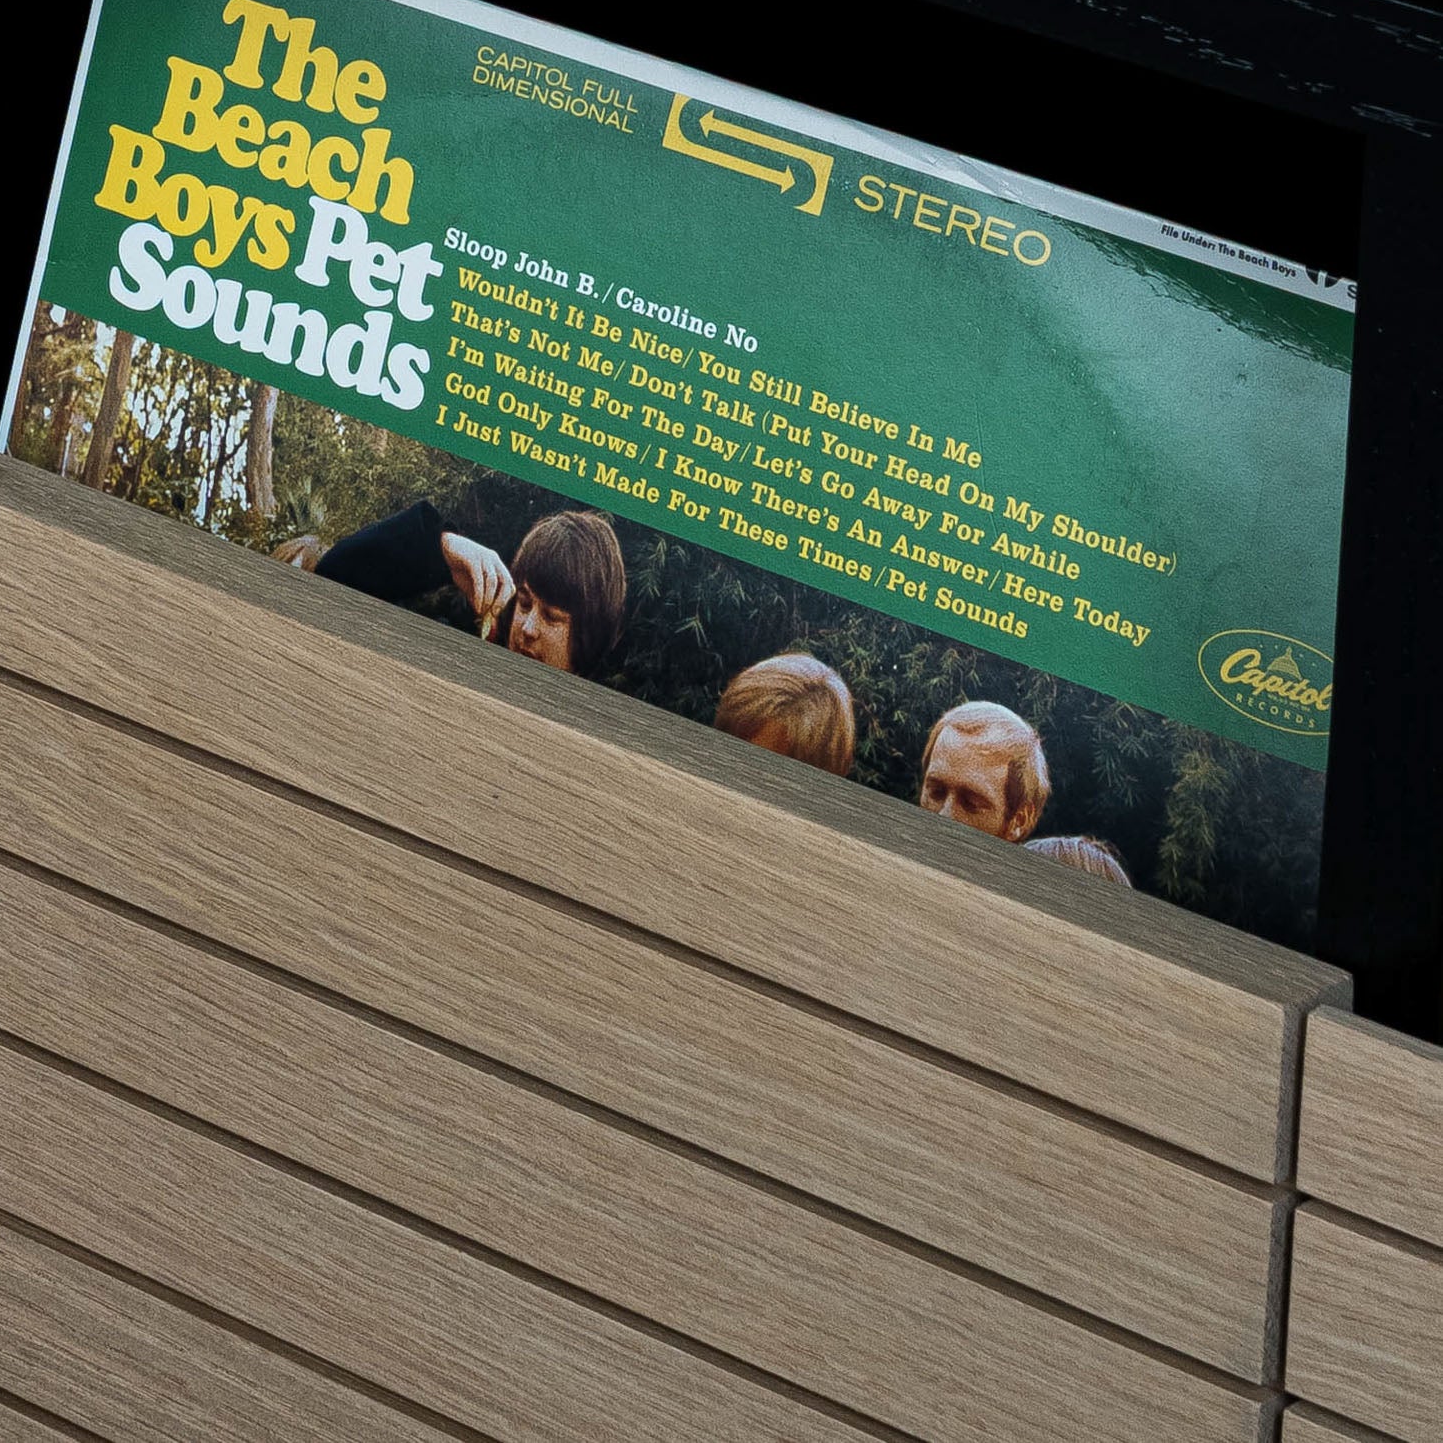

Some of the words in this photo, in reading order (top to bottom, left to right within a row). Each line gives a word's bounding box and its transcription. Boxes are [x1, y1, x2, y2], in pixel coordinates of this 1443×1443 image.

[151, 54, 415, 225] Beach
[472, 65, 634, 134] DIMENSIONAL
[477, 45, 574, 93] CAPITOL
[582, 80, 639, 114] FULL
[93, 123, 297, 271] Boys
[294, 195, 444, 322] Pet
[443, 226, 508, 270] Sloop
[513, 250, 569, 288] John
[615, 286, 717, 339] Caroline
[722, 322, 758, 353] No
[853, 174, 1052, 267] STEREO
[1160, 224, 1180, 240] File
[1181, 230, 1217, 251] Under:
[1217, 241, 1236, 258] The
[1237, 249, 1270, 270] Beach
[1271, 260, 1297, 279] Boys
[108, 222, 432, 411] Sounds
[457, 265, 559, 321] Wouldn't
[563, 304, 585, 330] It
[589, 313, 623, 343] Be
[697, 350, 741, 385] You
[747, 369, 802, 407] Still
[807, 389, 899, 440] Believe
[905, 423, 934, 453] In
[941, 435, 982, 469] Me
[434, 403, 448, 426] I
[452, 410, 502, 446] Just
[509, 429, 587, 477] Wasn't
[592, 461, 660, 504] Made
[665, 488, 711, 522] For
[717, 505, 789, 551] These
[933, 586, 1028, 638] Sounds
[444, 371, 491, 406] God
[497, 390, 554, 431] Only
[653, 446, 668, 469] I
[672, 453, 743, 496] Know
[750, 480, 840, 532] There's
[845, 517, 882, 548] An
[1000, 571, 1064, 612] Here
[1072, 596, 1151, 647] Today
[446, 335, 484, 368] I'm
[493, 351, 586, 408] Waiting
[589, 386, 634, 420] For
[640, 404, 685, 439] The
[751, 444, 813, 485] Let's
[820, 469, 855, 499] Go
[861, 485, 933, 531] Away
[937, 510, 985, 545] For
[989, 531, 1081, 580] Awhile
[450, 299, 521, 344] That's
[526, 327, 571, 362] Not
[627, 363, 694, 405] Don't
[700, 388, 757, 427] Talk
[761, 409, 812, 447] (Put
[820, 430, 879, 470] Your
[883, 453, 951, 496] Head
[958, 480, 995, 513] On
[1001, 495, 1045, 532] My
[1050, 513, 1177, 575] Shoulder)
[1219, 647, 1333, 711] Capitol
[1235, 692, 1315, 729] RECORDS
